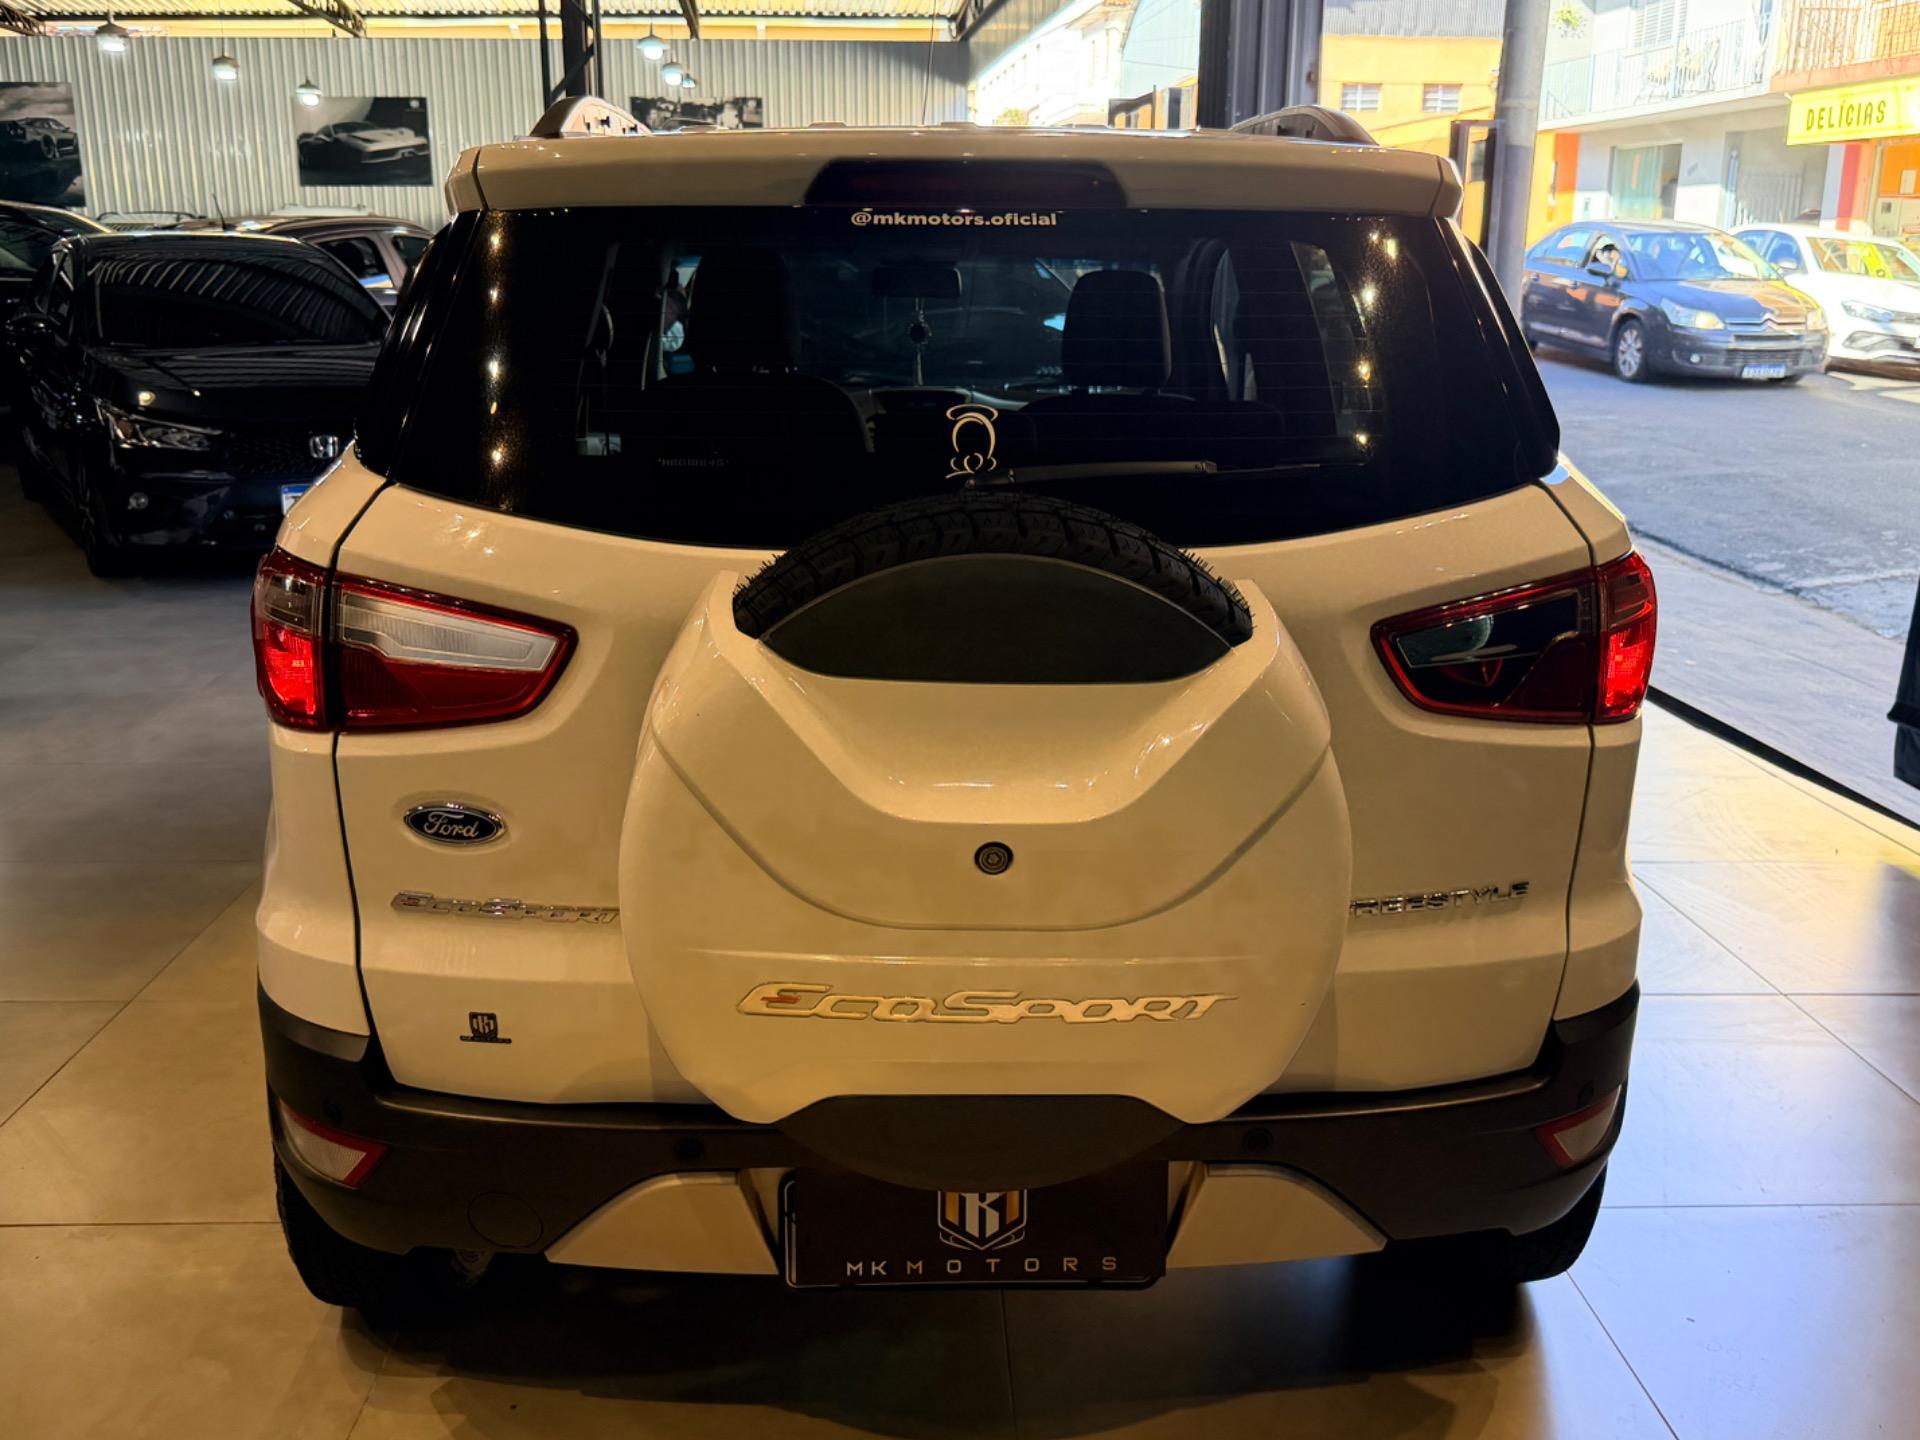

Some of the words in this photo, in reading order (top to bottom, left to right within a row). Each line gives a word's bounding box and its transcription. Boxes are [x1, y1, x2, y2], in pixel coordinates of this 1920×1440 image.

[1806, 99, 1886, 131] DELÍCIAS
[850, 212, 1057, 227] @mkmotors.oficial
[423, 811, 479, 838] Ford
[1350, 881, 1530, 917] REESTYLE
[846, 1260, 887, 1277] MK
[906, 1256, 1118, 1276] MOTORS
